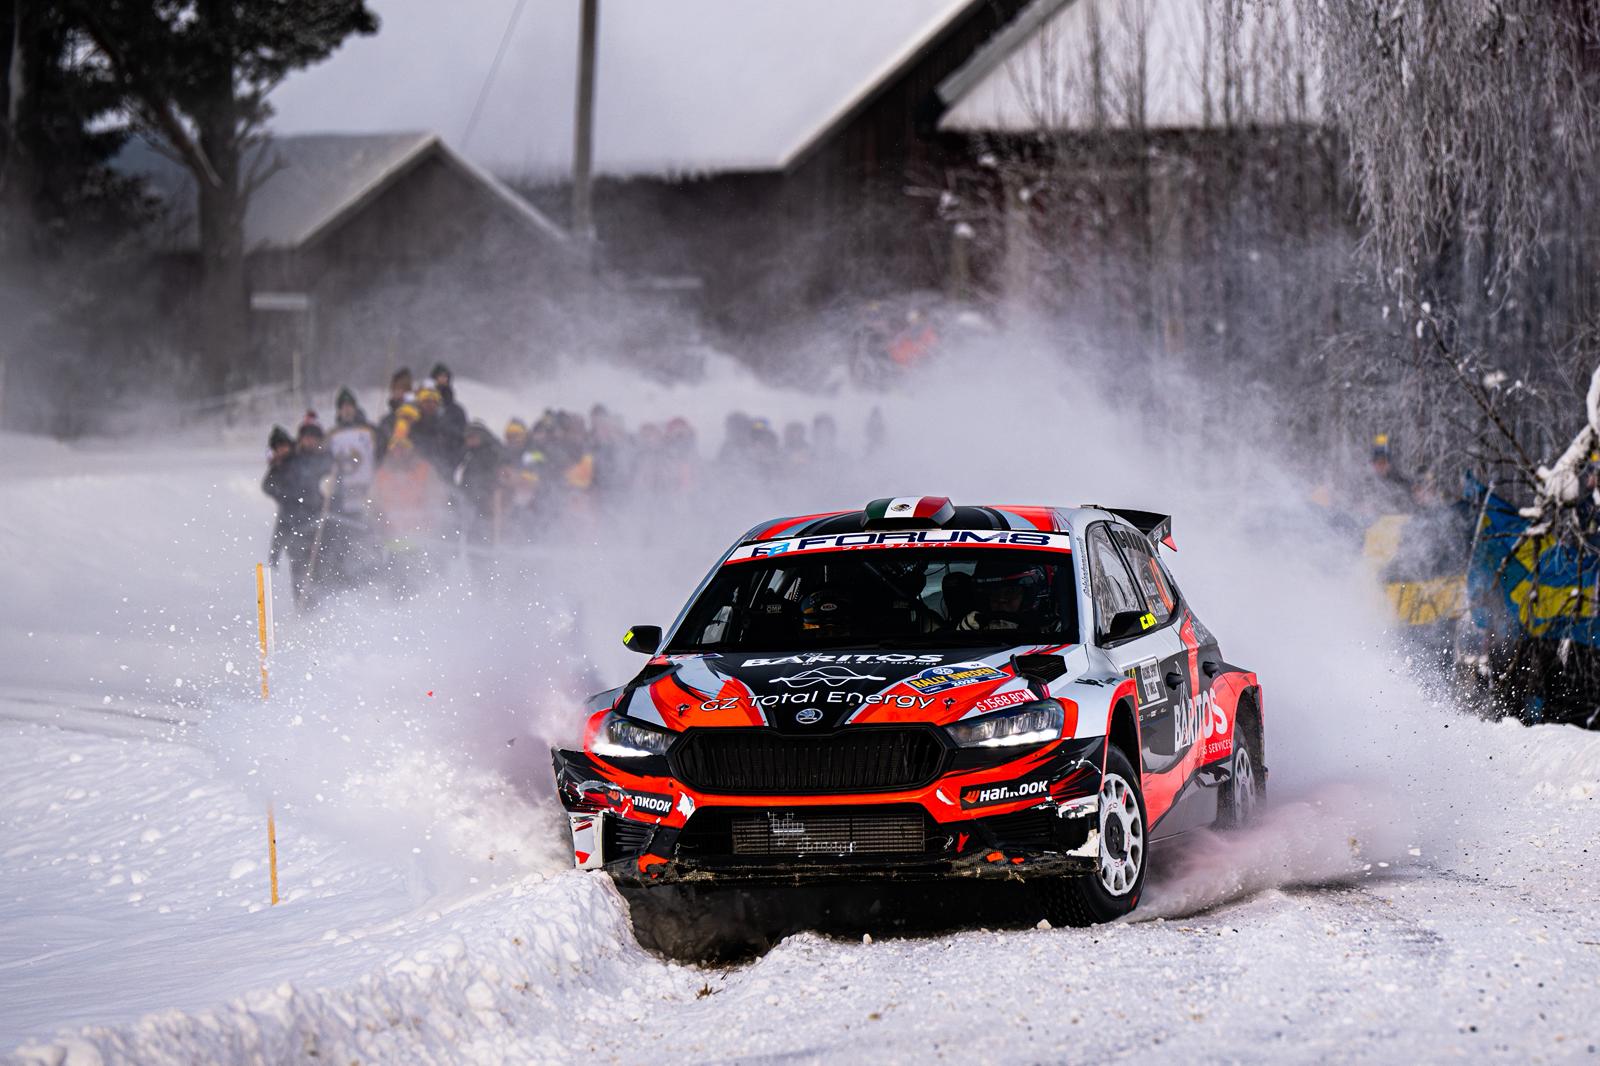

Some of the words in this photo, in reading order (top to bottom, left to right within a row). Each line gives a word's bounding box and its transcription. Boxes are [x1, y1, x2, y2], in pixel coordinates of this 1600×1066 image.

[798, 530, 1050, 550] FORUM8
[741, 653, 945, 667] BARITOS
[910, 675, 949, 688] RALLY
[947, 667, 997, 680] SWEDEN
[700, 697, 739, 711] GZ
[748, 690, 819, 707] Total
[826, 691, 934, 709] Energy
[976, 702, 986, 711] S
[984, 695, 1011, 708] 1568
[1010, 690, 1032, 703] BCM
[1173, 687, 1228, 753] BARITOS
